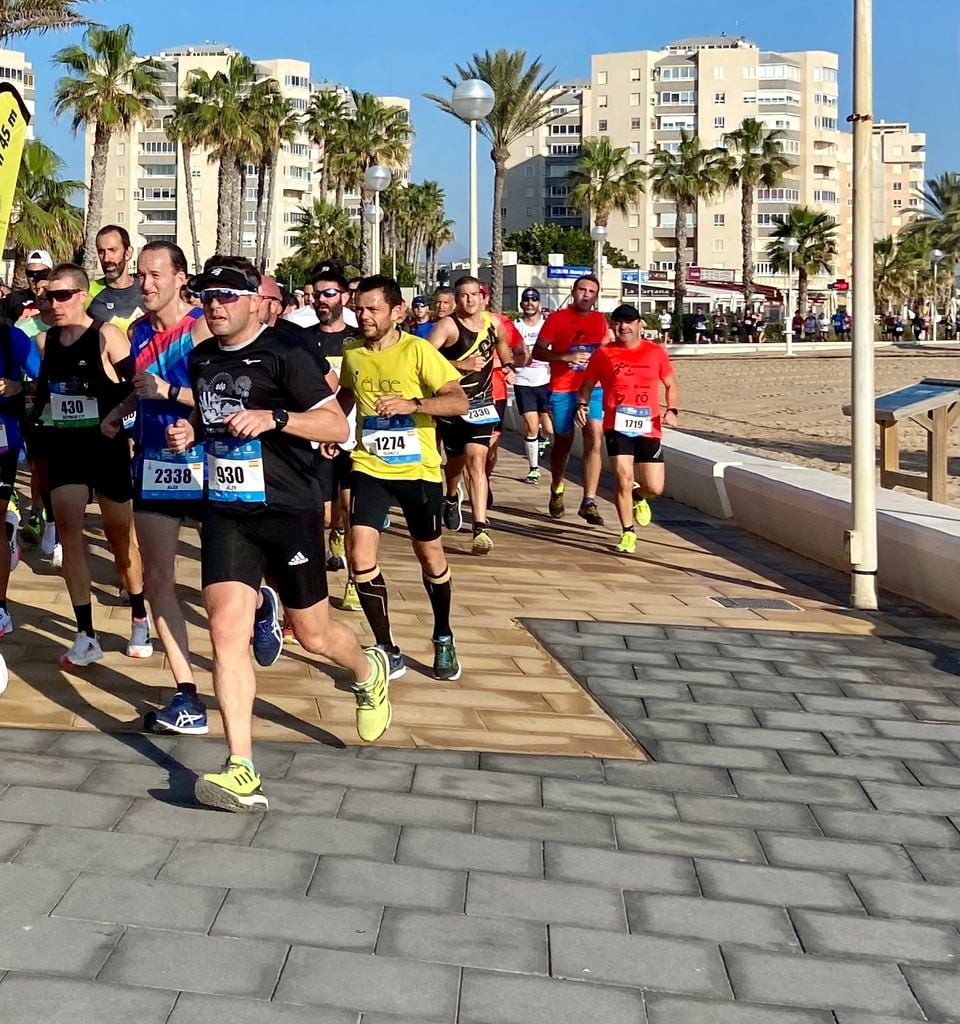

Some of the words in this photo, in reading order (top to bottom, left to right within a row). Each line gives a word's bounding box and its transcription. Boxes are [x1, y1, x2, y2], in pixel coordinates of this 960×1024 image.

[0, 123, 11, 150] 45
[8, 108, 18, 128] m
[61, 400, 84, 414] 430
[625, 419, 643, 429] 1719
[375, 436, 406, 451] 1274
[154, 468, 192, 484] 2338
[216, 466, 245, 484] 930
